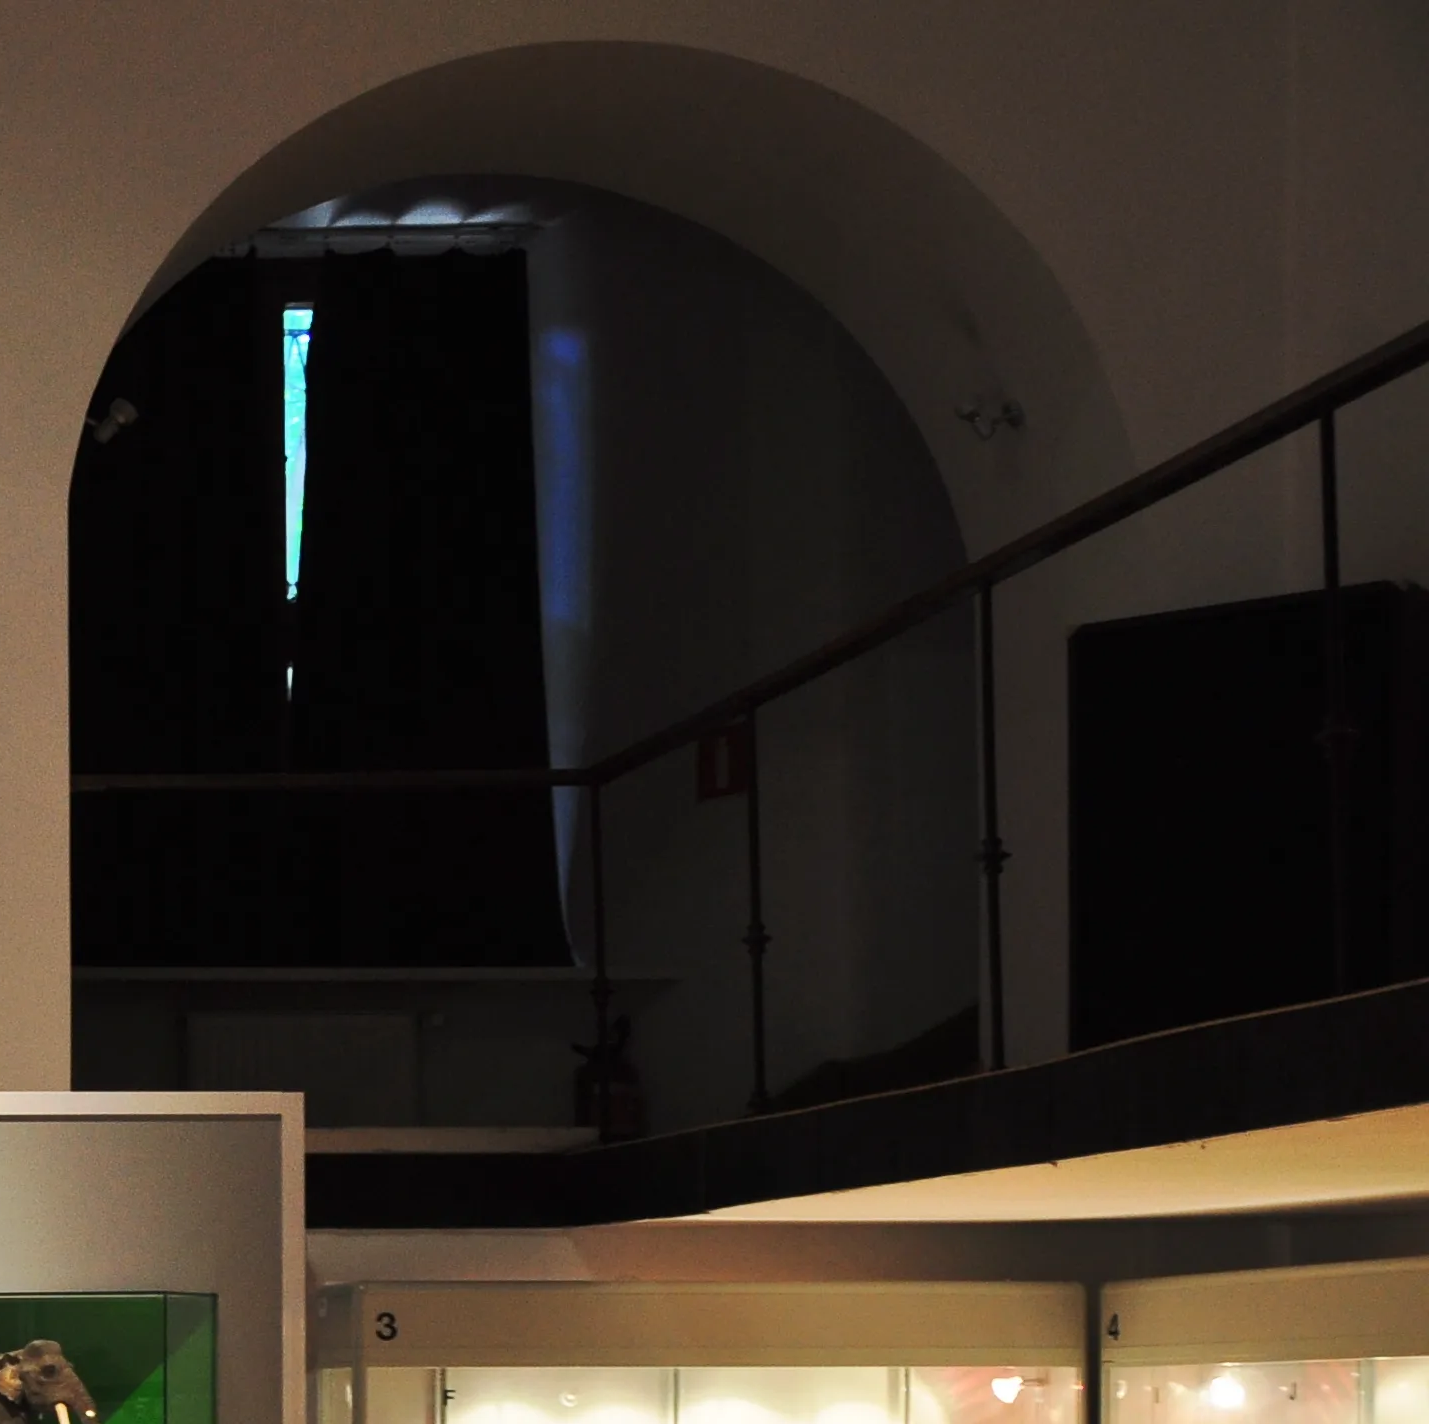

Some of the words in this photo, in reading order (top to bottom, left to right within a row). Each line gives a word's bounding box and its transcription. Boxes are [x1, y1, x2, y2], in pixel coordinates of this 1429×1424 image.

[376, 1311, 398, 1342] 3
[1107, 1313, 1120, 1341] 4
[443, 1389, 456, 1407] F
